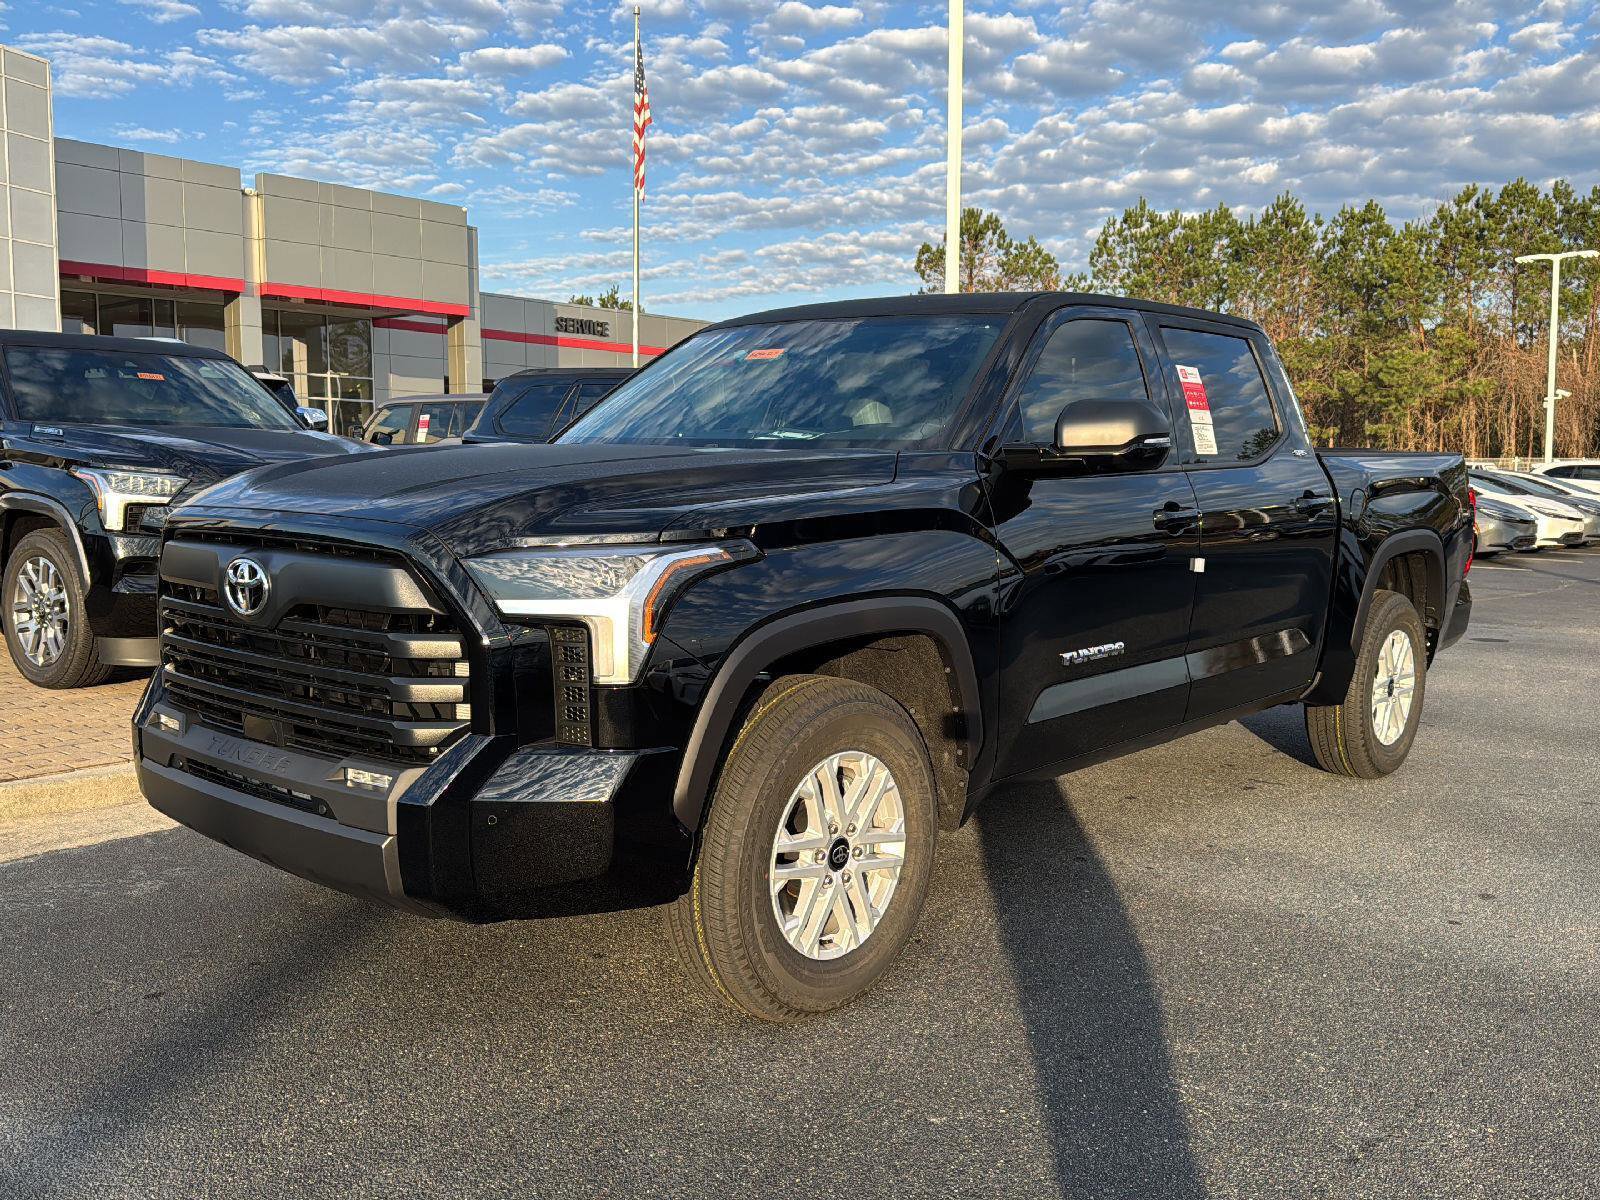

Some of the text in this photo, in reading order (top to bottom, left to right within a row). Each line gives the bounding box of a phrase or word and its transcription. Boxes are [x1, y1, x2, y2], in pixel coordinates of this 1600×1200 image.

[555, 316, 610, 337] SERVICE
[1060, 641, 1125, 666] TUNDRA
[207, 736, 291, 774] TUNDRA
